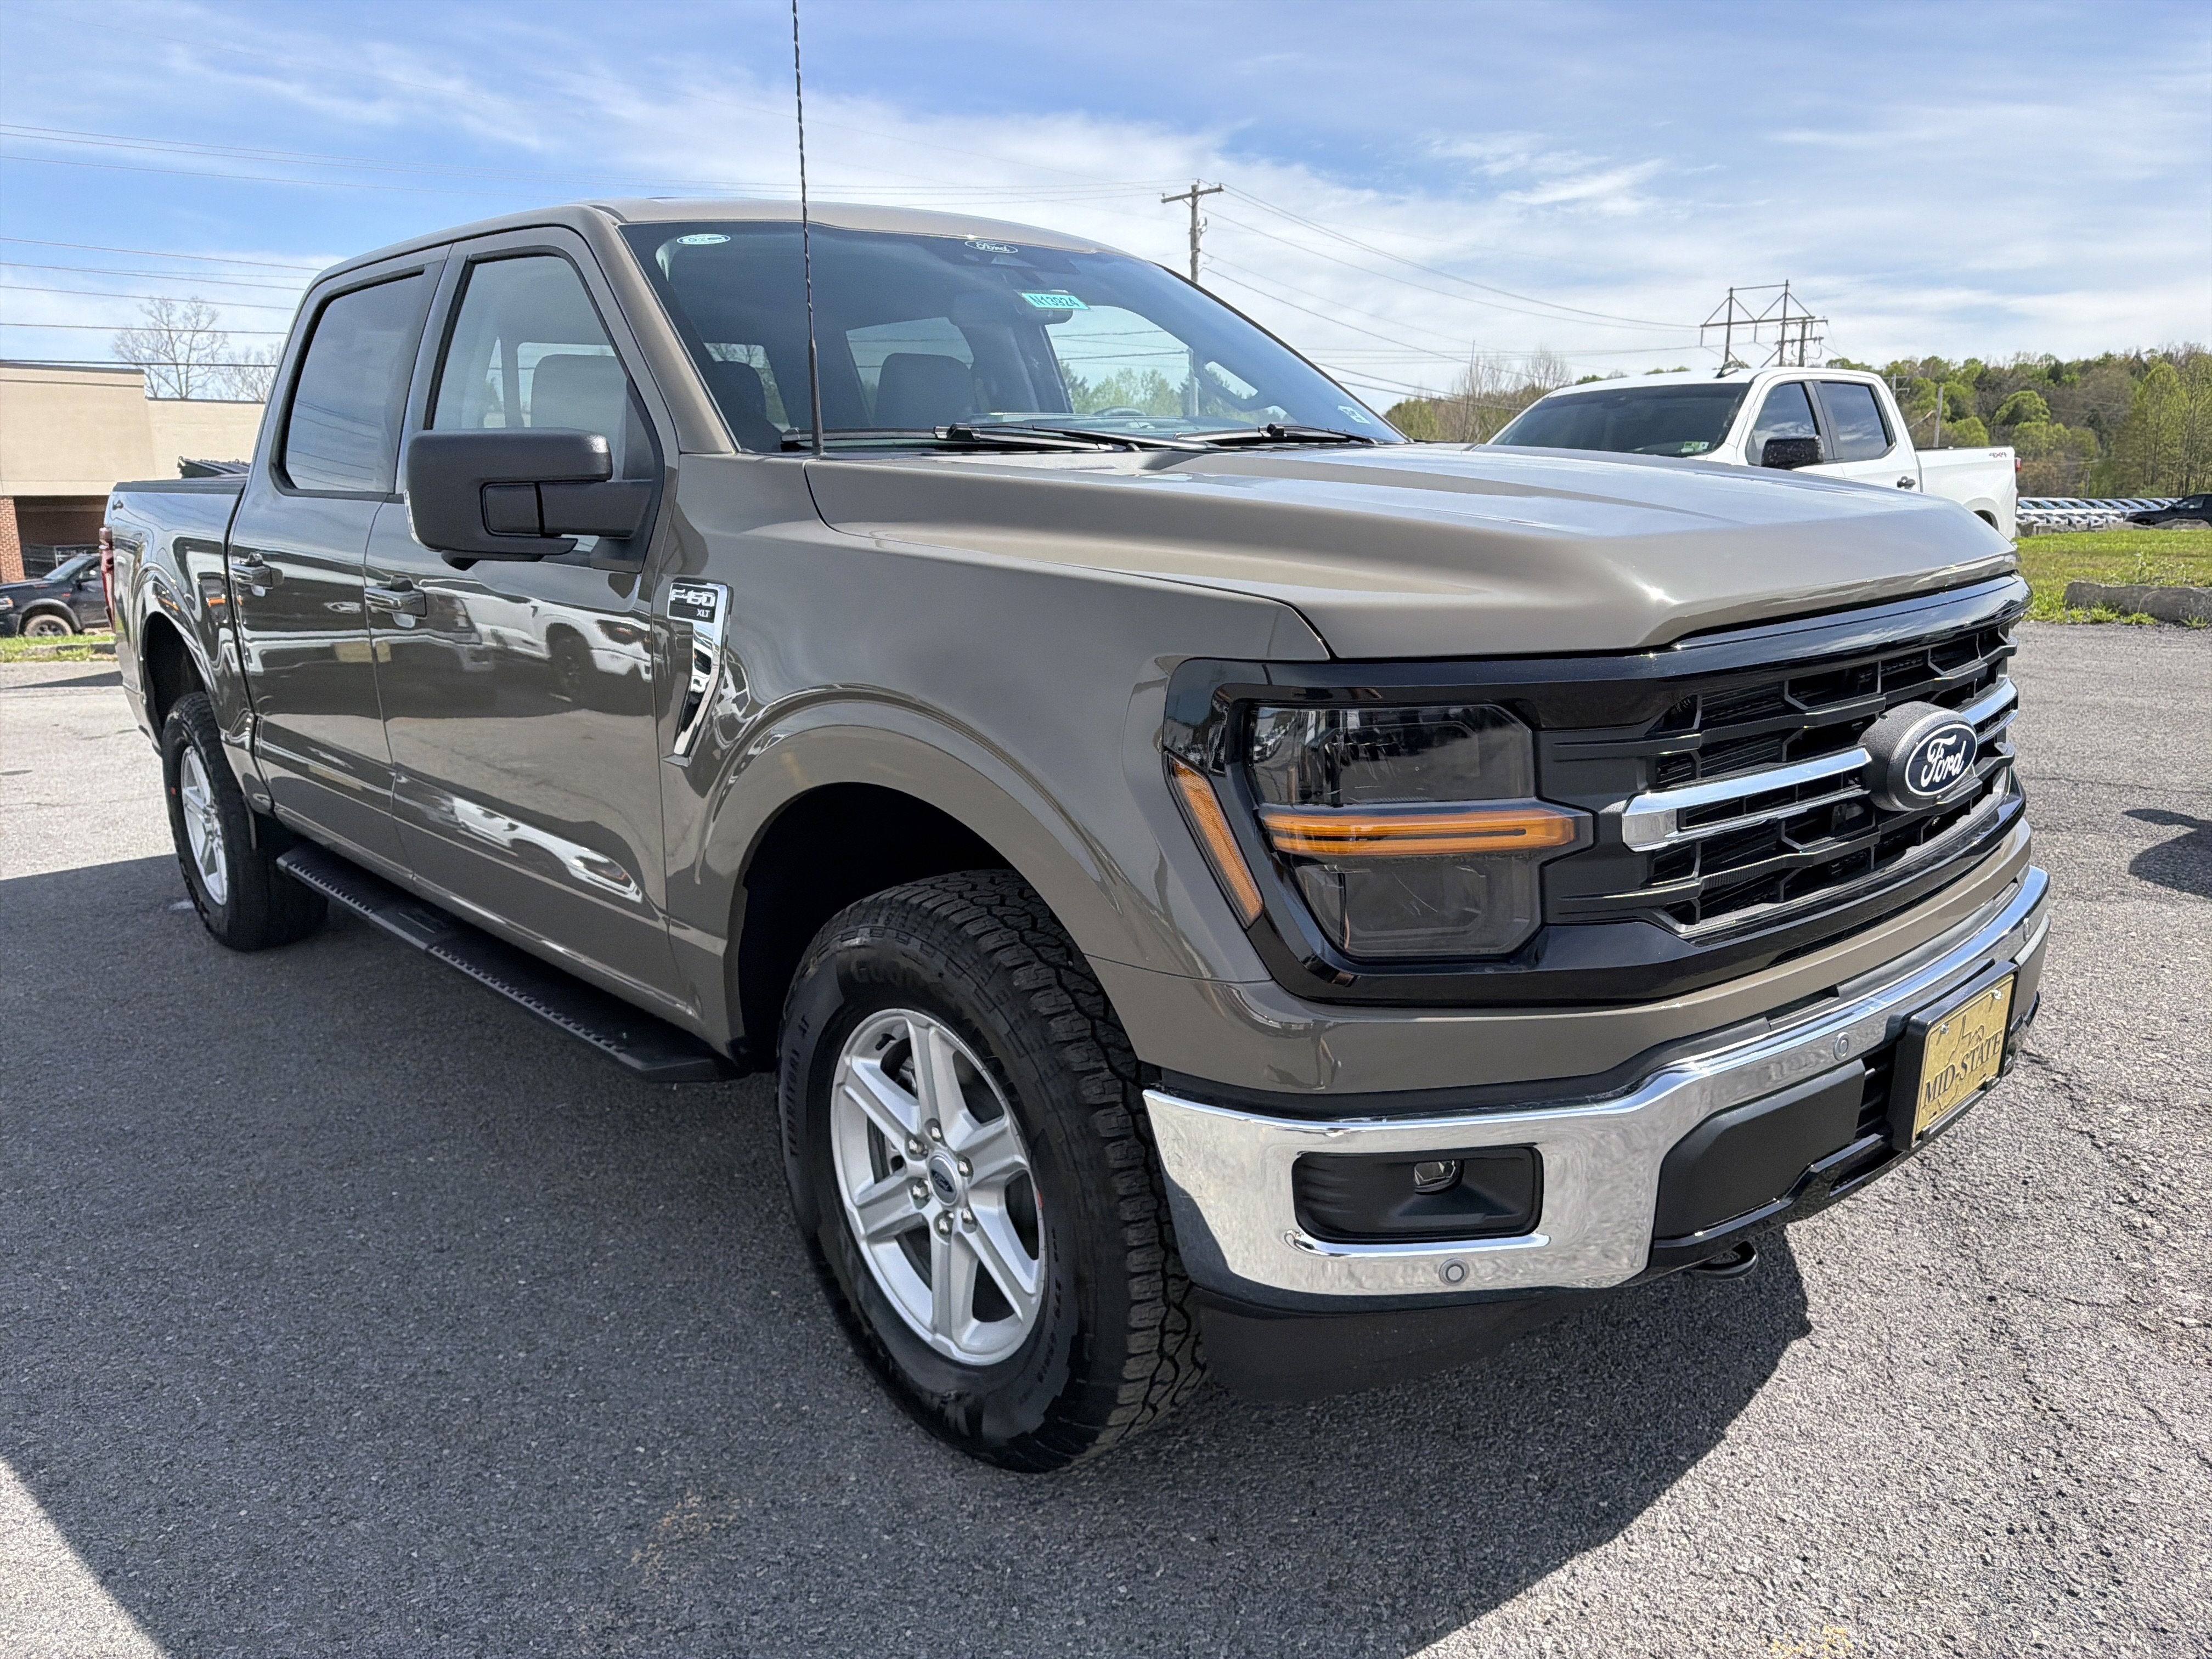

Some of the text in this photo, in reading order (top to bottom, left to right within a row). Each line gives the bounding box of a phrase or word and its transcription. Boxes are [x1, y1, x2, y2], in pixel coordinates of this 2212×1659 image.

[975, 241, 1009, 252] Ford
[1029, 295, 1080, 307] N13924
[696, 608, 710, 618] XLT
[1920, 734, 1967, 788] Ford
[1923, 1031, 2003, 1107] MID-STATE
